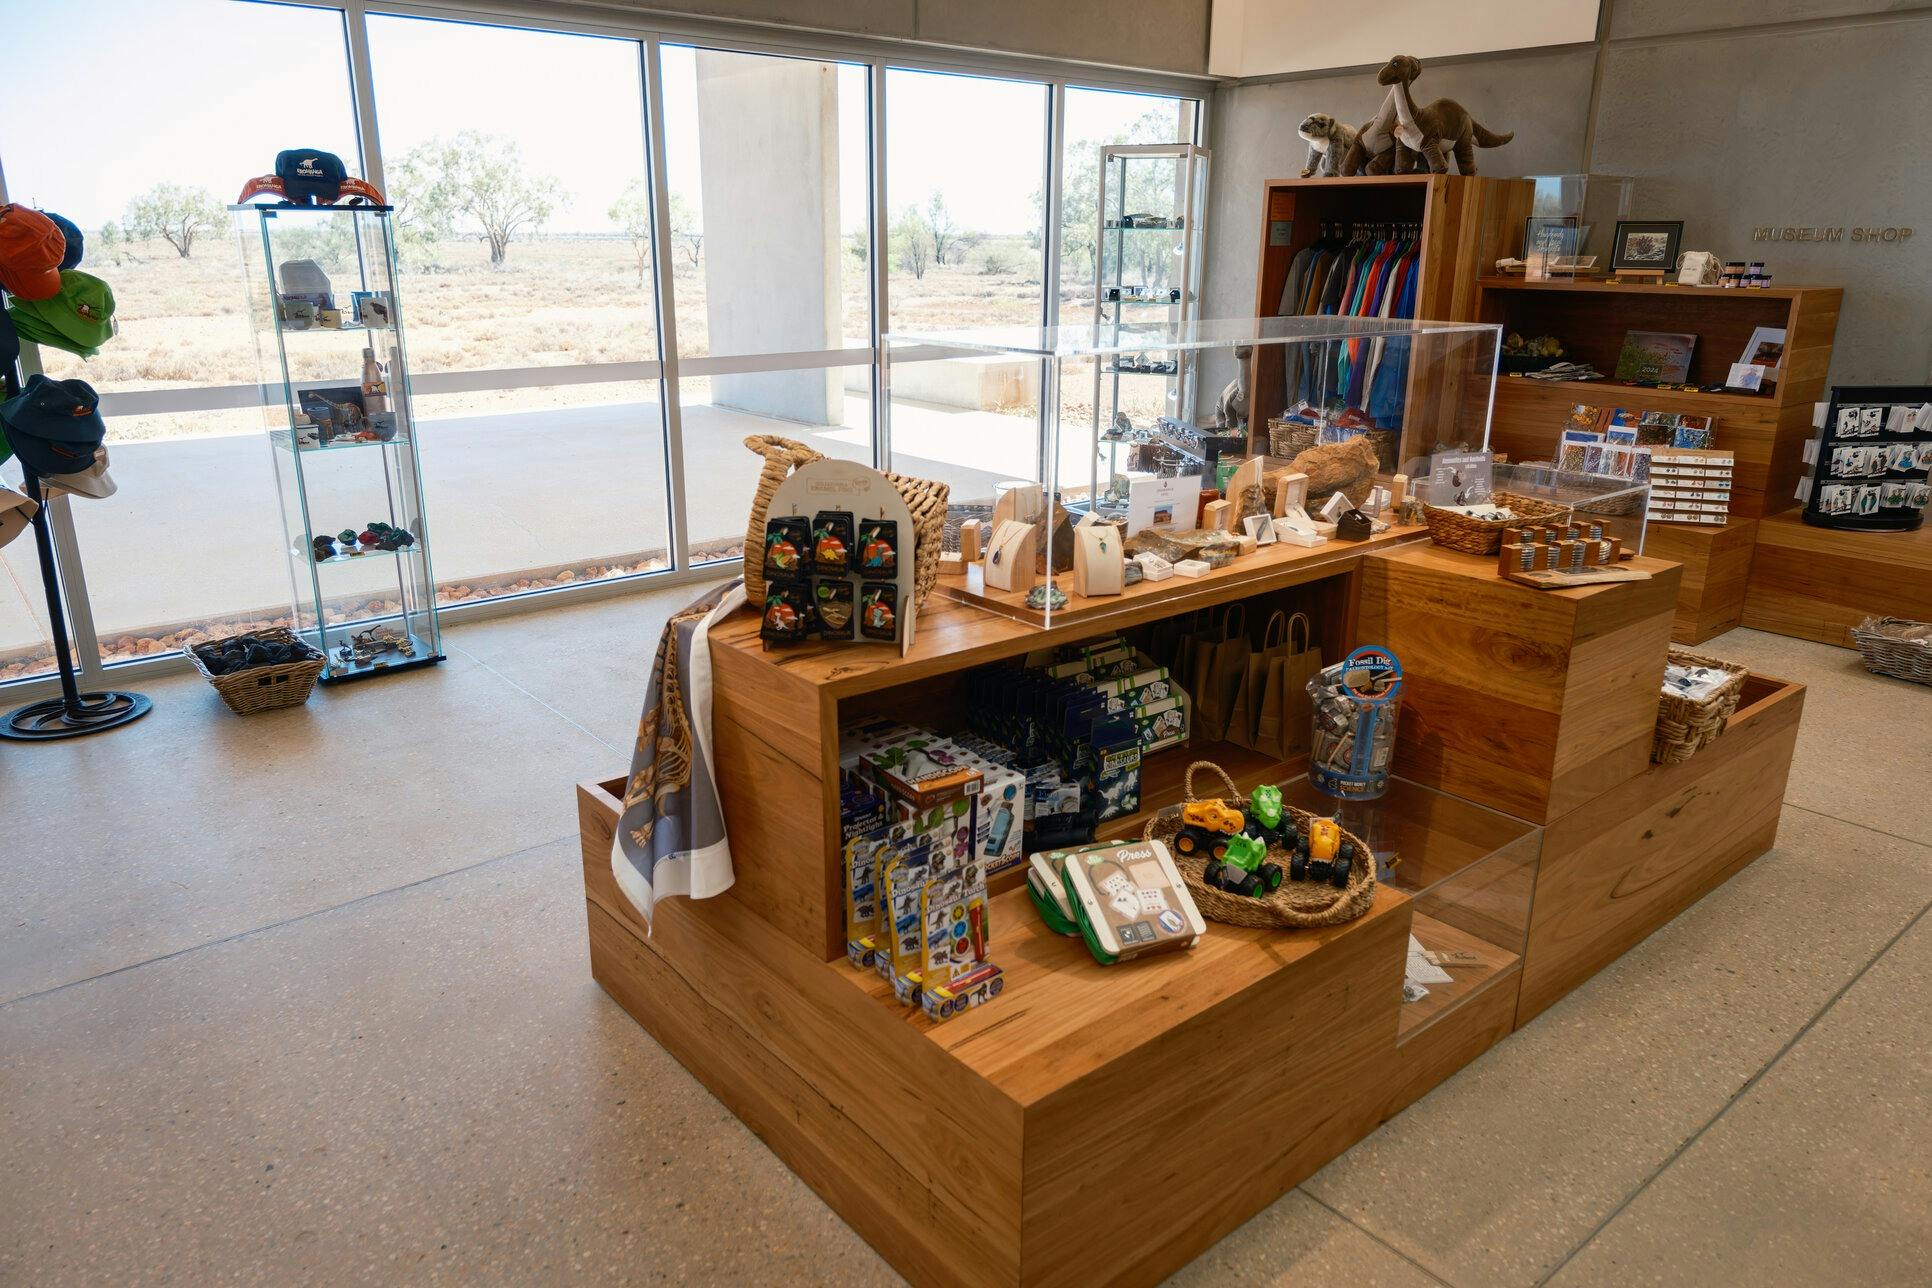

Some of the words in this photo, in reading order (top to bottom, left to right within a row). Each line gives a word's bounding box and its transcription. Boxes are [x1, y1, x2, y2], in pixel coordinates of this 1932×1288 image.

[1753, 227, 1845, 242] MUSEUM
[1851, 227, 1914, 242] SHOP
[1349, 656, 1374, 667] Fossil
[1376, 656, 1392, 666] Dig
[843, 816, 877, 832] Projector
[1116, 849, 1152, 862] Press
[927, 895, 962, 912] Dinosaur
[963, 882, 986, 897] Torch
